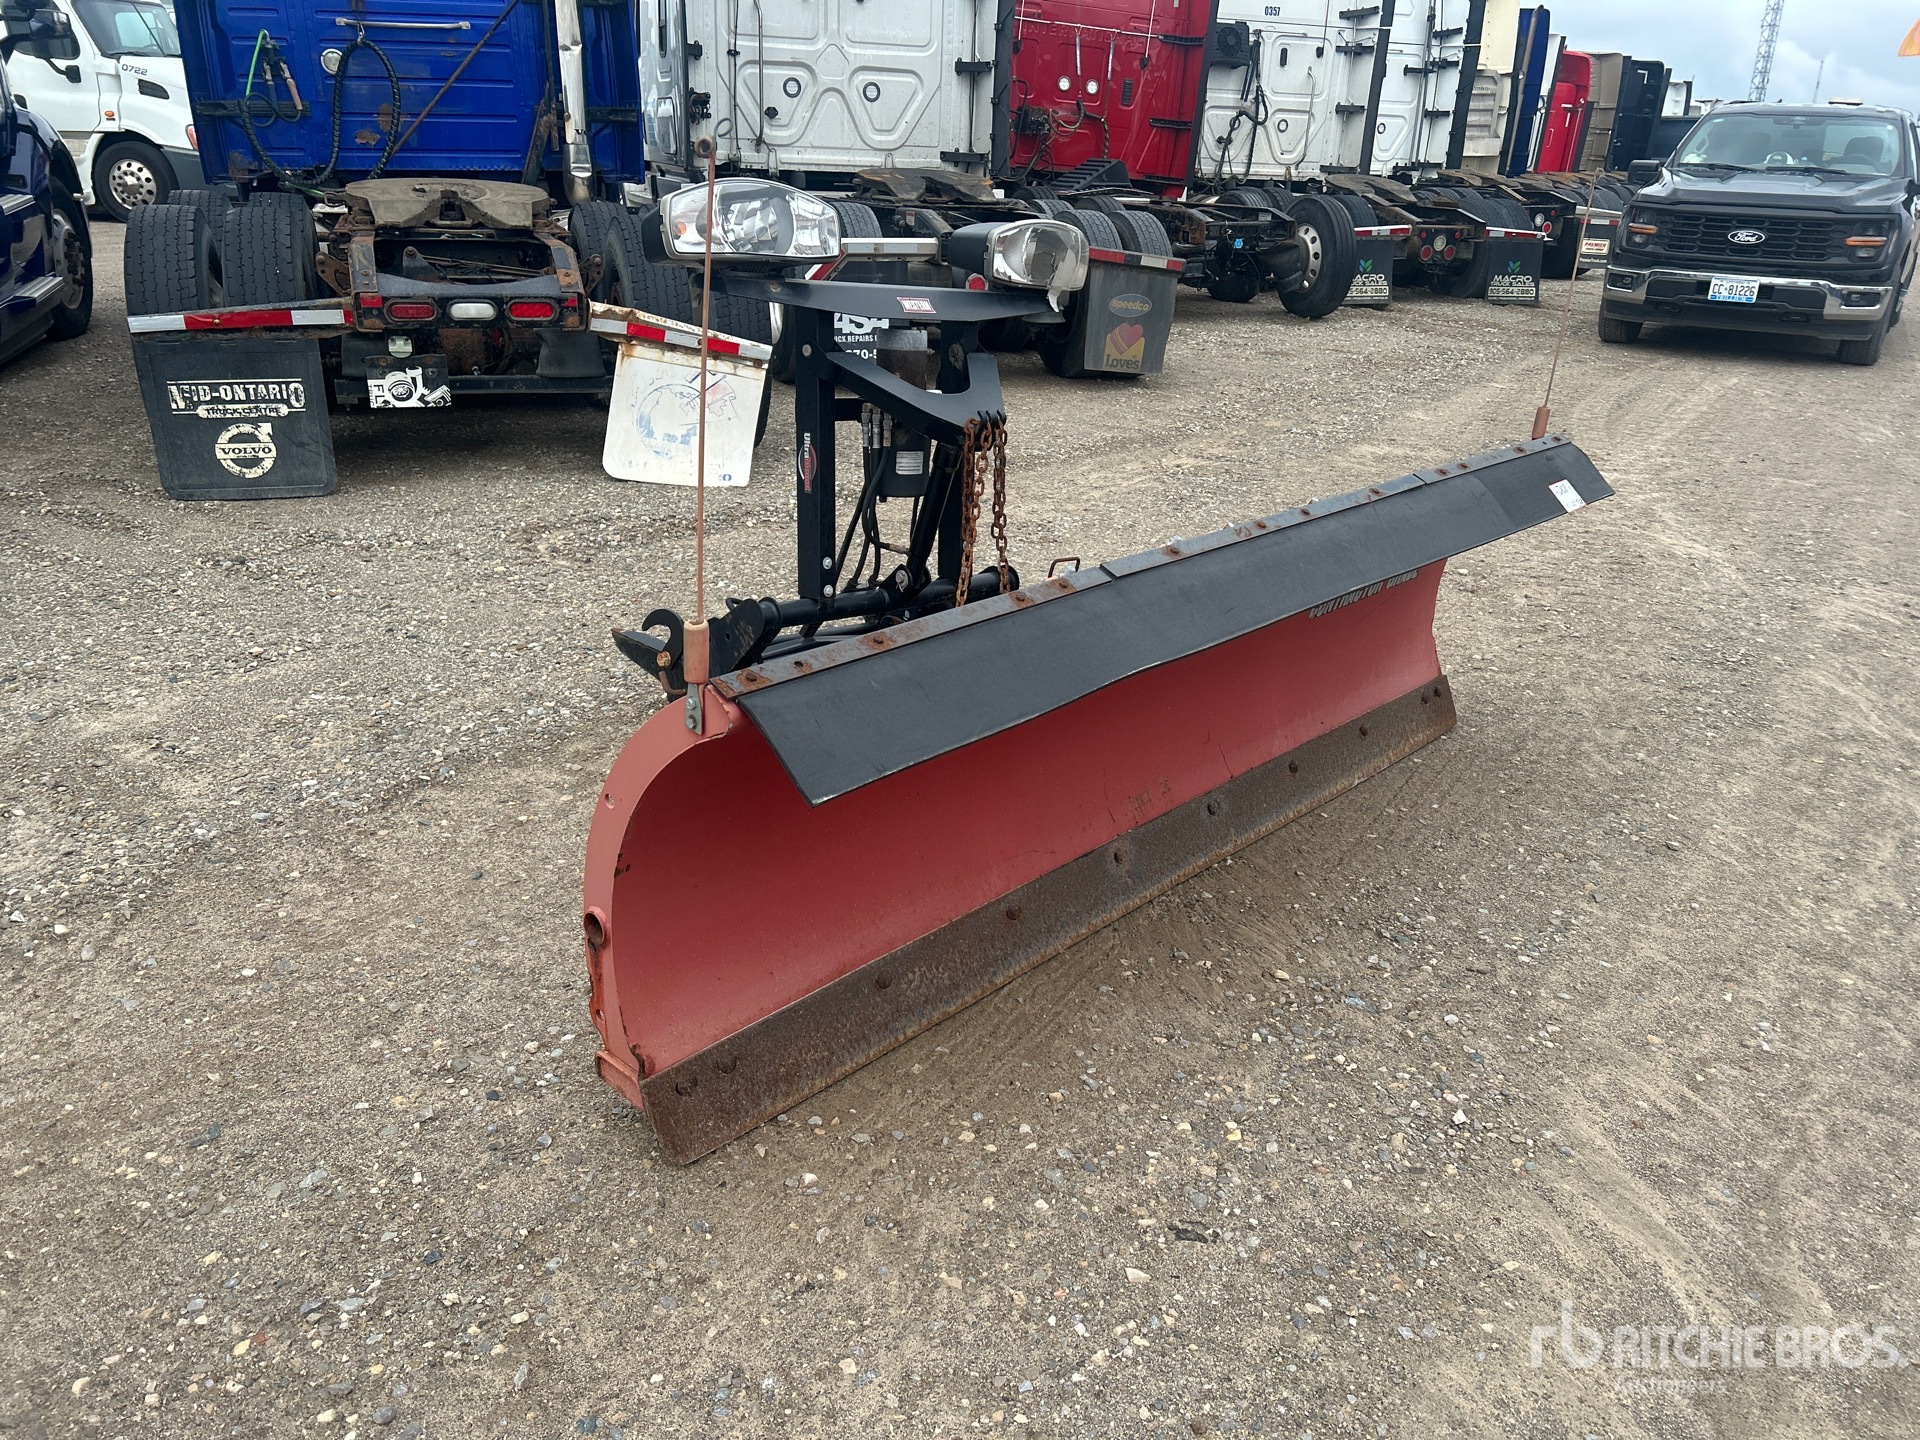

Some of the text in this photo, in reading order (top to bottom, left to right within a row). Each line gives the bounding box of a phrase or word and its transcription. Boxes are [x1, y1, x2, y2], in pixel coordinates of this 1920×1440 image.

[1264, 5, 1280, 16] 0357
[121, 63, 148, 76] 0722
[1352, 273, 1385, 282] ACRO
[1493, 274, 1533, 283] MACRO
[1111, 299, 1149, 312] speedco
[847, 334, 874, 342] REPAIRS
[204, 406, 281, 417] TRUCK CENTRE
[220, 446, 273, 455] VOLVO
[803, 432, 812, 492] UltraMount
